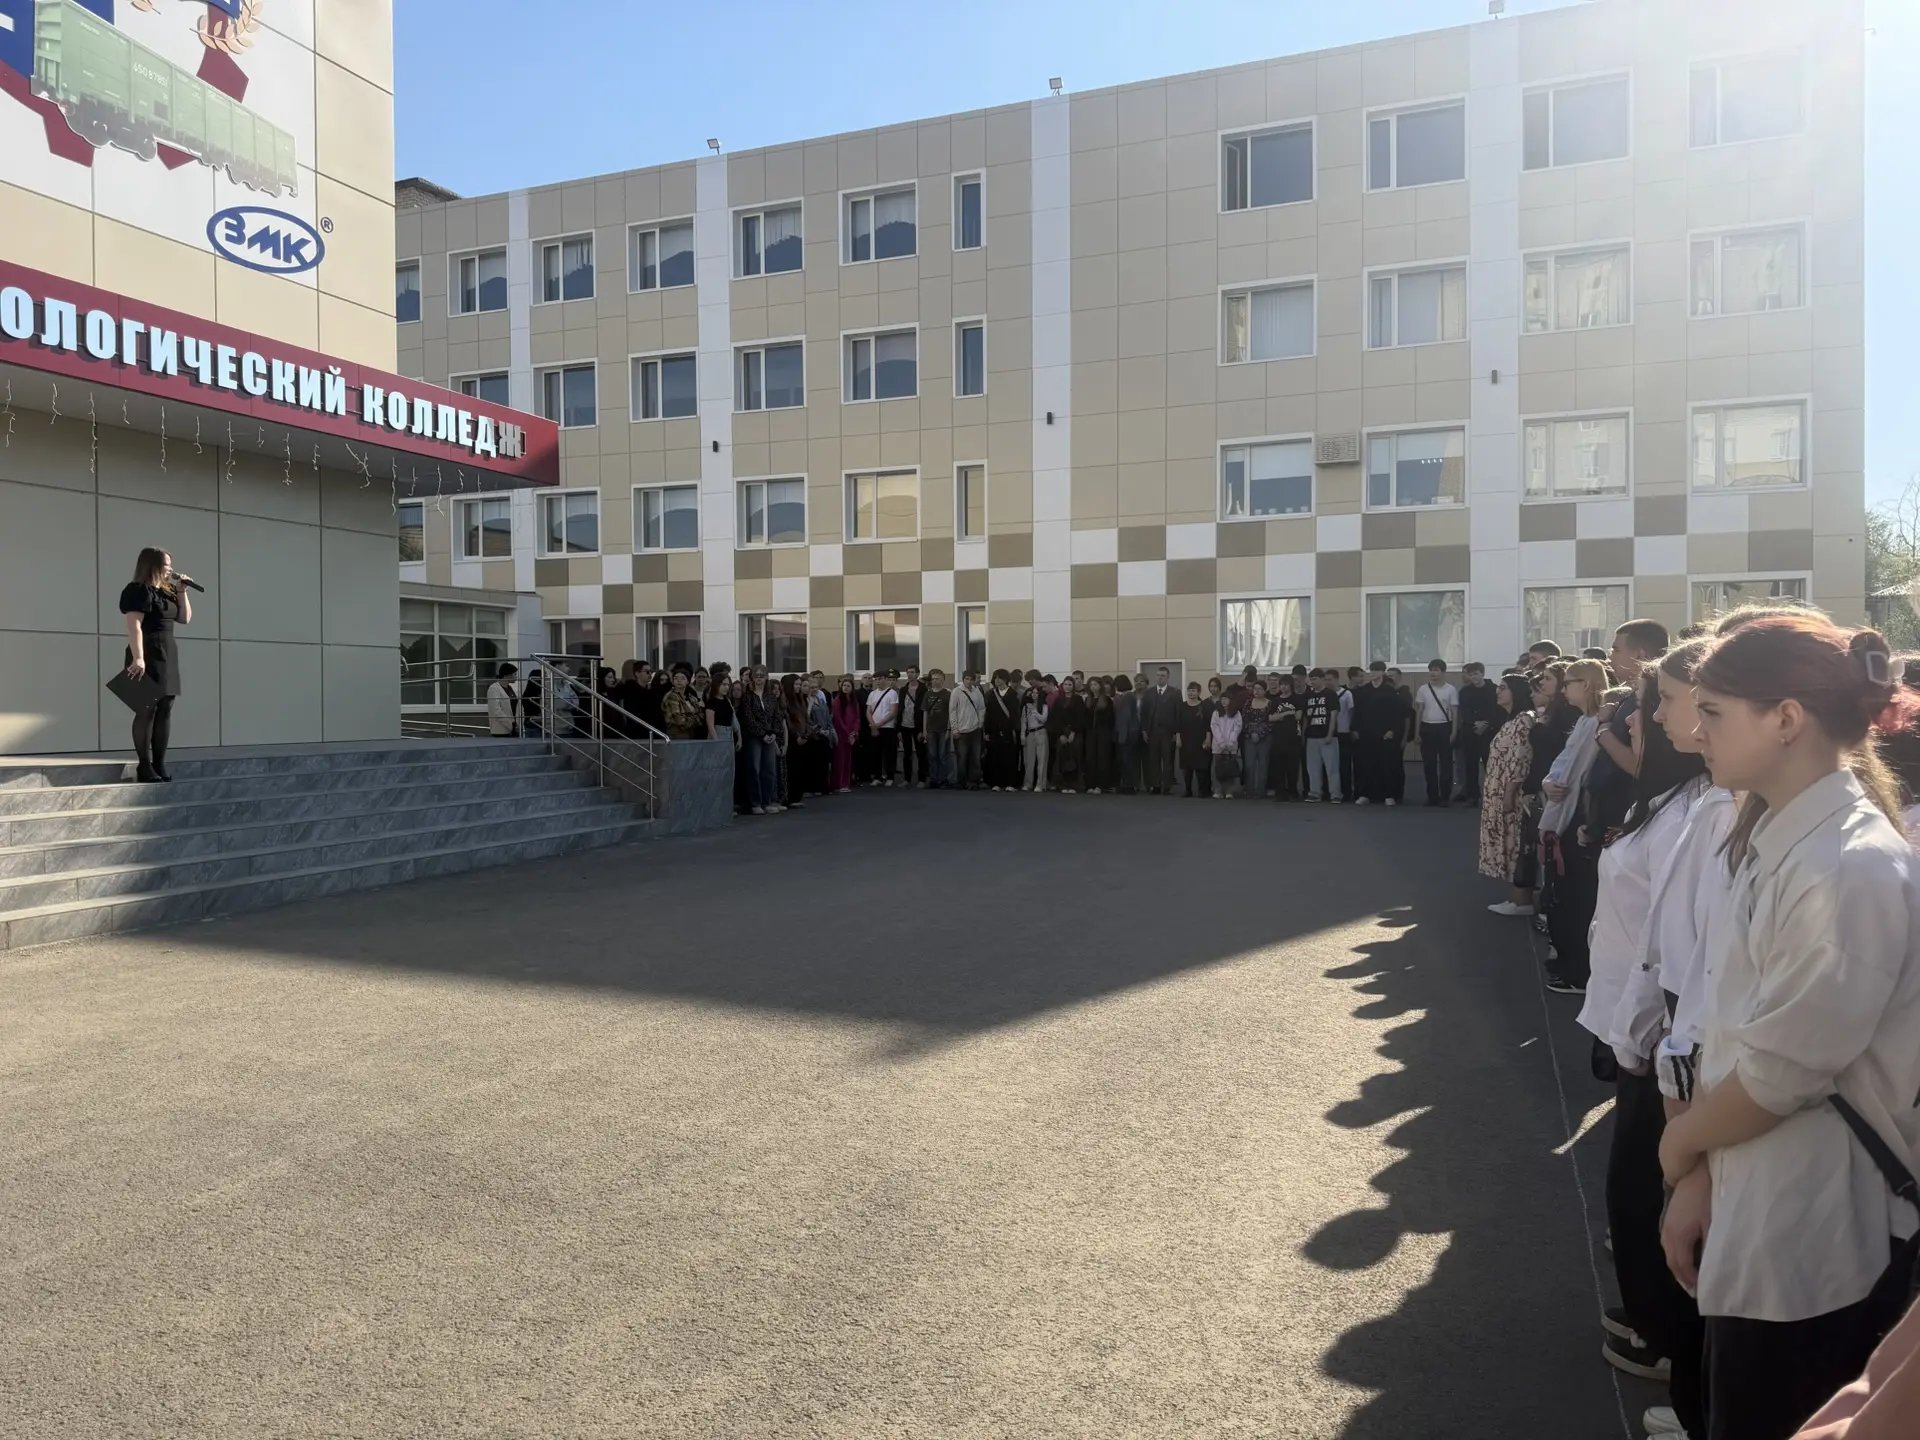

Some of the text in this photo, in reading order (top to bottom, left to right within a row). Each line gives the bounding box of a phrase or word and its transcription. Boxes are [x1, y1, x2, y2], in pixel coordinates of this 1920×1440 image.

[225, 213, 312, 267] ЗМК
[0, 286, 521, 458] ОЛОГИЧЕСКИЙ КОЛЛЕДЖ
